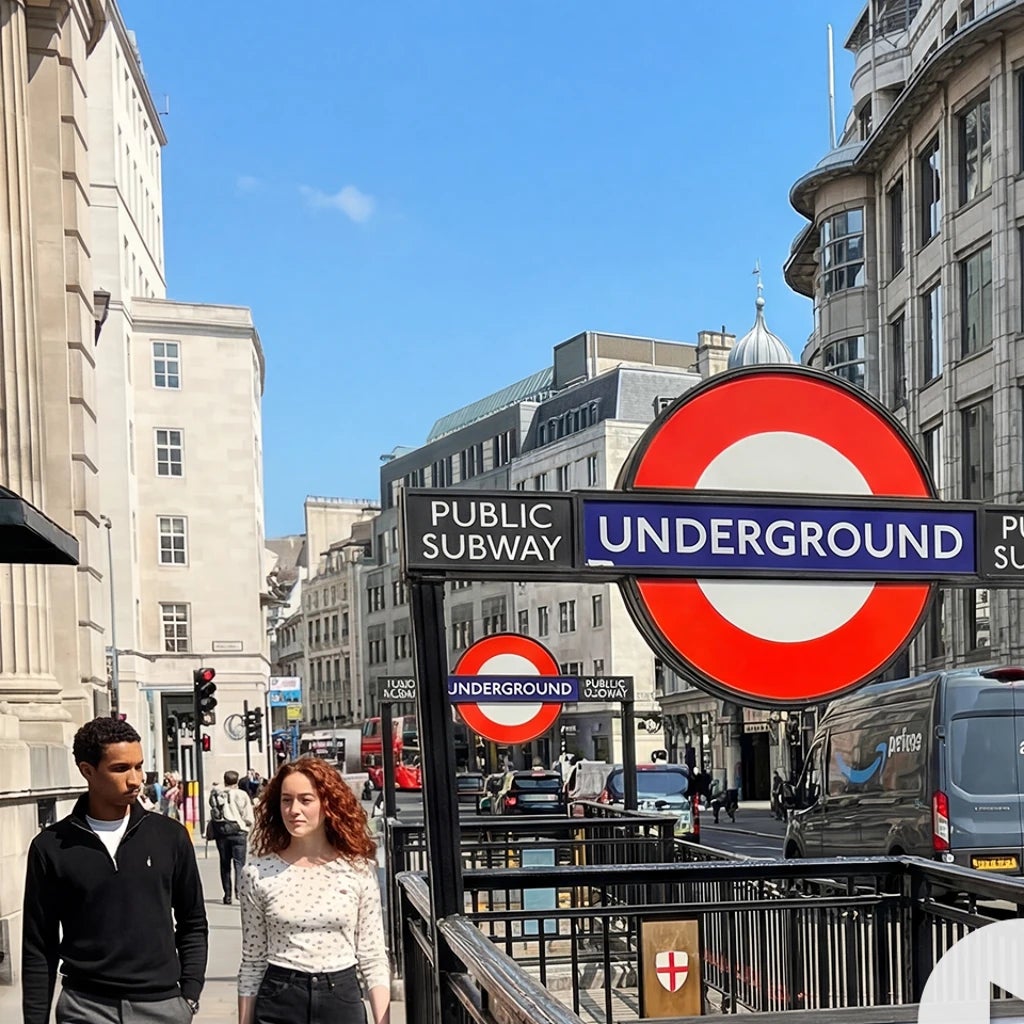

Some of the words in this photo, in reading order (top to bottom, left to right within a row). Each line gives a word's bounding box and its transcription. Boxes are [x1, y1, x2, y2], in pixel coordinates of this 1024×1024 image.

[431, 500, 553, 530] PUBLIC
[422, 532, 563, 562] SUBWAY
[598, 514, 964, 560] UNDERGROUND
